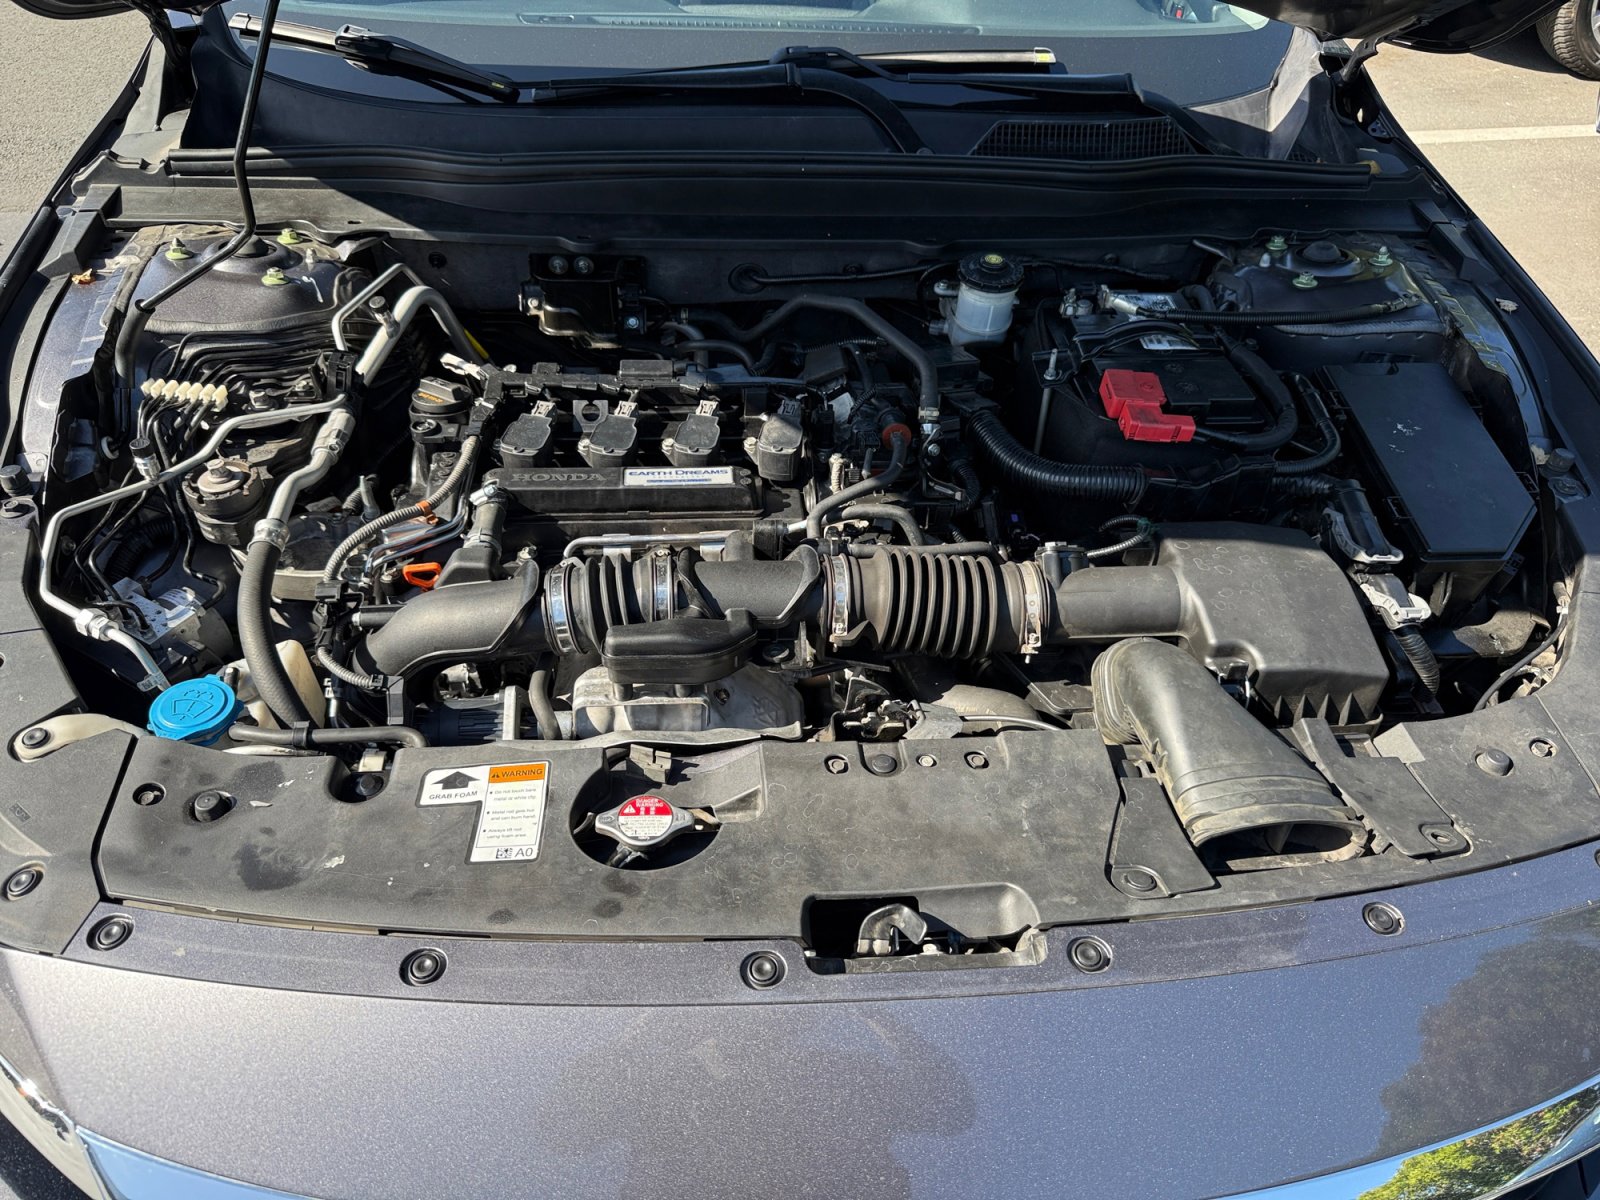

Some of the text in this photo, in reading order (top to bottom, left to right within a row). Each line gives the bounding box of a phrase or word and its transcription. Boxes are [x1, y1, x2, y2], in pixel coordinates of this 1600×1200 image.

[511, 472, 607, 482] HONDA
[501, 768, 543, 778] WARNING
[429, 790, 479, 800] GRAB FOAM
[514, 847, 533, 858] A0
